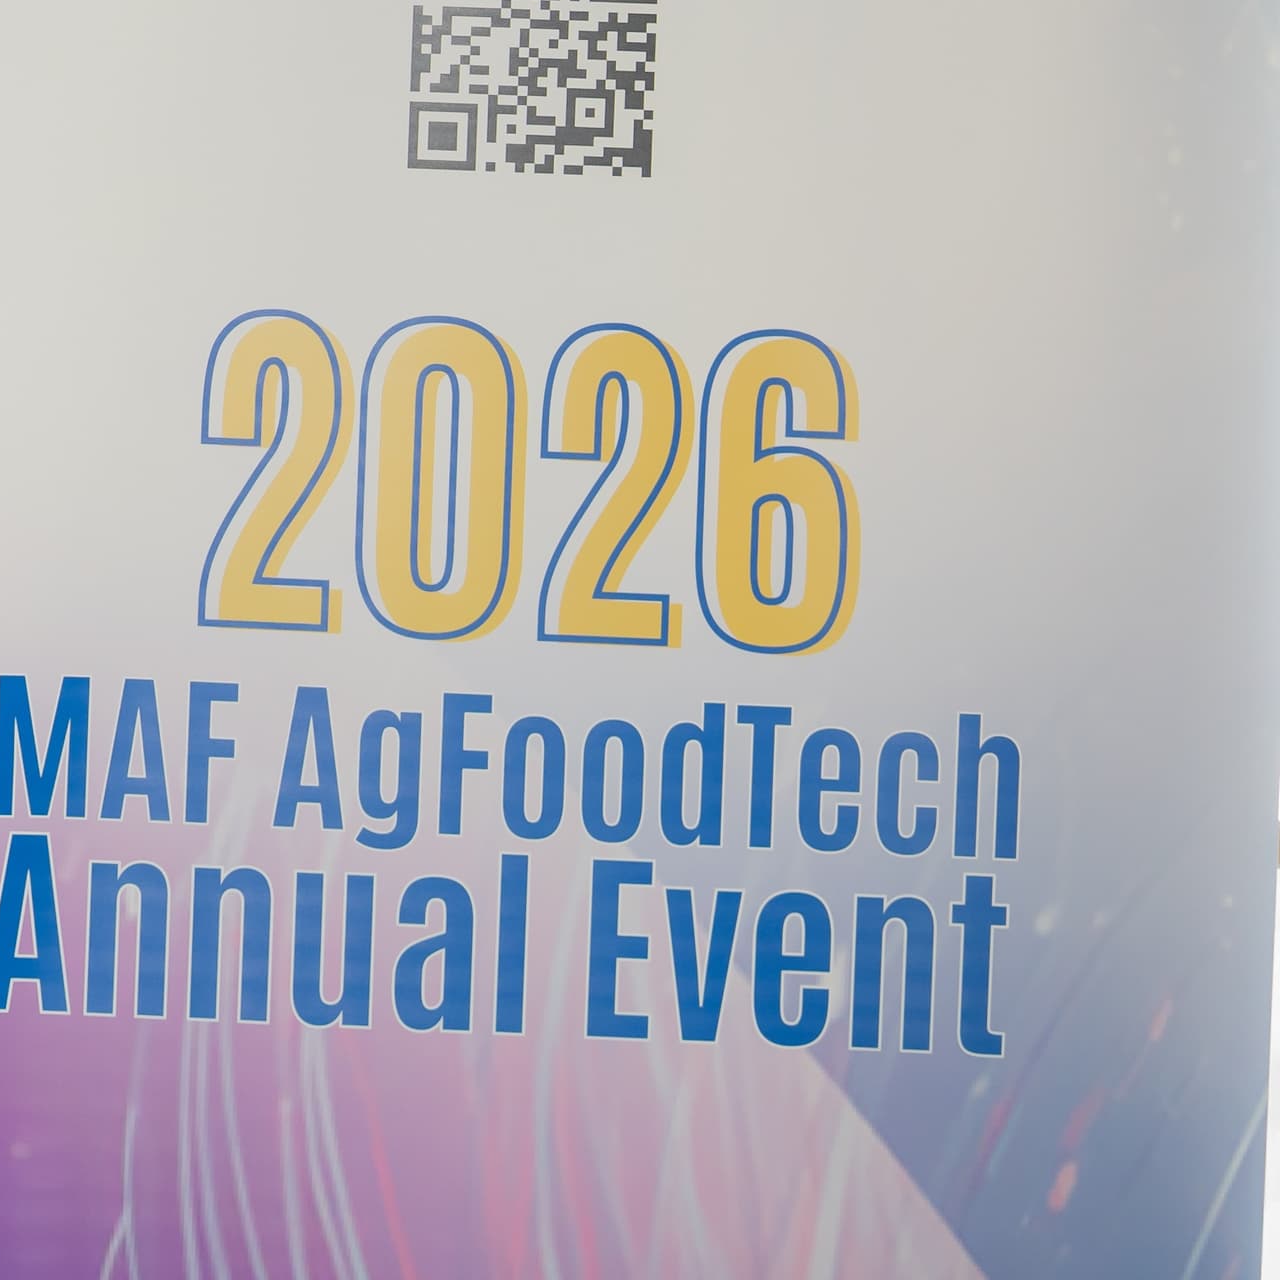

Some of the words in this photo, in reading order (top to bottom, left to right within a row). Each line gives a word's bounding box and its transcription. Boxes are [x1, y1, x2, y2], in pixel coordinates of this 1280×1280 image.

[197, 308, 862, 657] 2026
[272, 685, 1022, 861] AgFoodTech
[585, 858, 1008, 1057] Event
